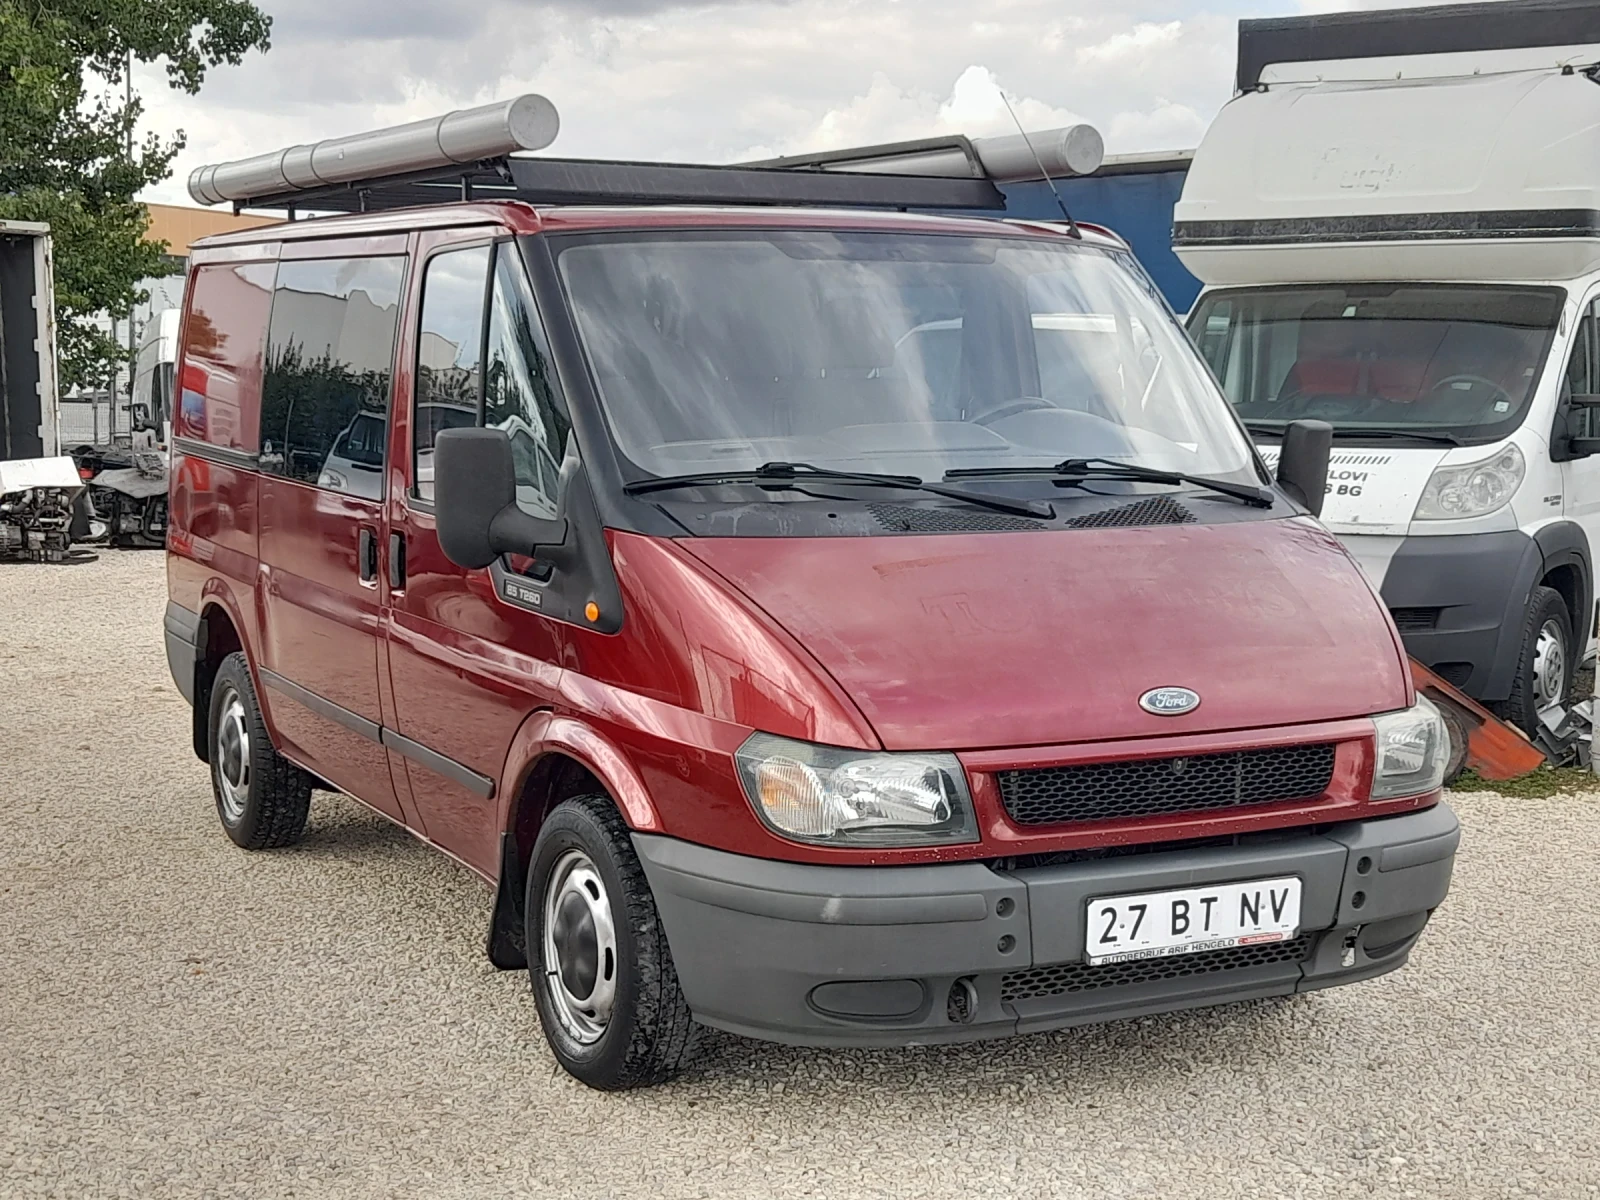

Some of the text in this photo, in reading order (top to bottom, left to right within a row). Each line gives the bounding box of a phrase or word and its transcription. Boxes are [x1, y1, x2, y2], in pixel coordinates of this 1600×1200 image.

[1328, 470, 1368, 482] LOVI
[1336, 484, 1362, 497] BG
[1156, 692, 1188, 708] Ford
[1099, 888, 1289, 944] 27 BT NV
[1168, 944, 1189, 955] ARIF
[1191, 938, 1235, 952] HENGELO
